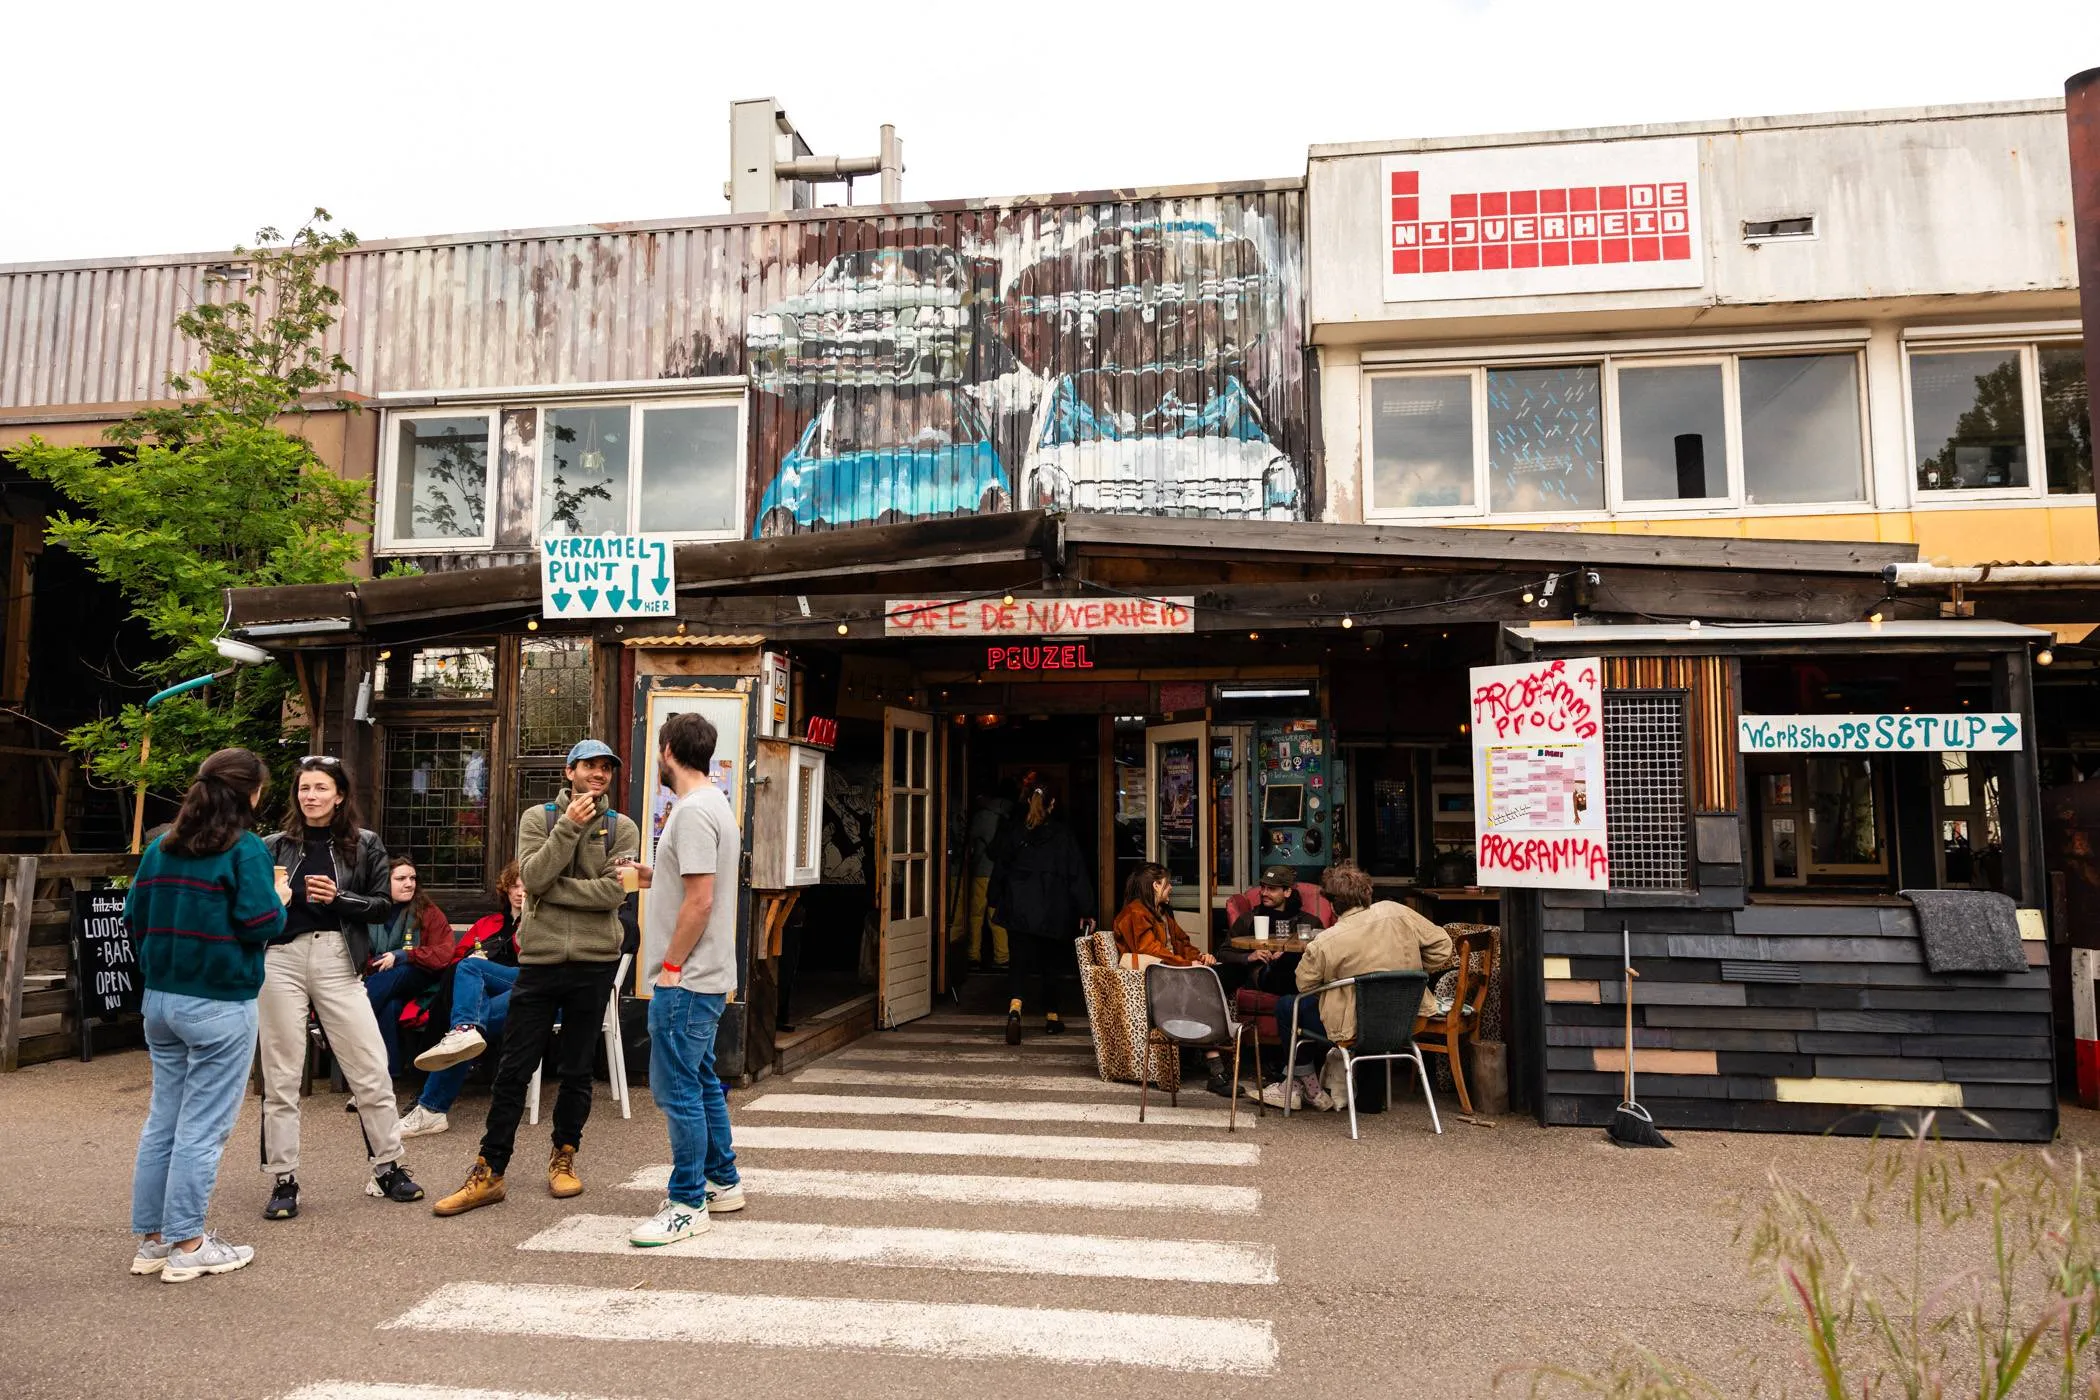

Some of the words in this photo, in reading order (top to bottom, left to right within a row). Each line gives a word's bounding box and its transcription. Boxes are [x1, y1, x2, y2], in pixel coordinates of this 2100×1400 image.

[1634, 185, 1684, 206] DE
[1395, 211, 1686, 244] NIJVERHEID
[545, 537, 651, 559] VERZAMEL
[549, 560, 619, 583] PUNT
[890, 600, 968, 630] CAFE
[981, 602, 1019, 632] DE
[988, 645, 1093, 669] PEUZEL
[1480, 833, 1607, 881] PROGRAMMA
[84, 917, 128, 938] LOODS
[96, 971, 133, 995] OPEN
[105, 995, 121, 1010] NU
